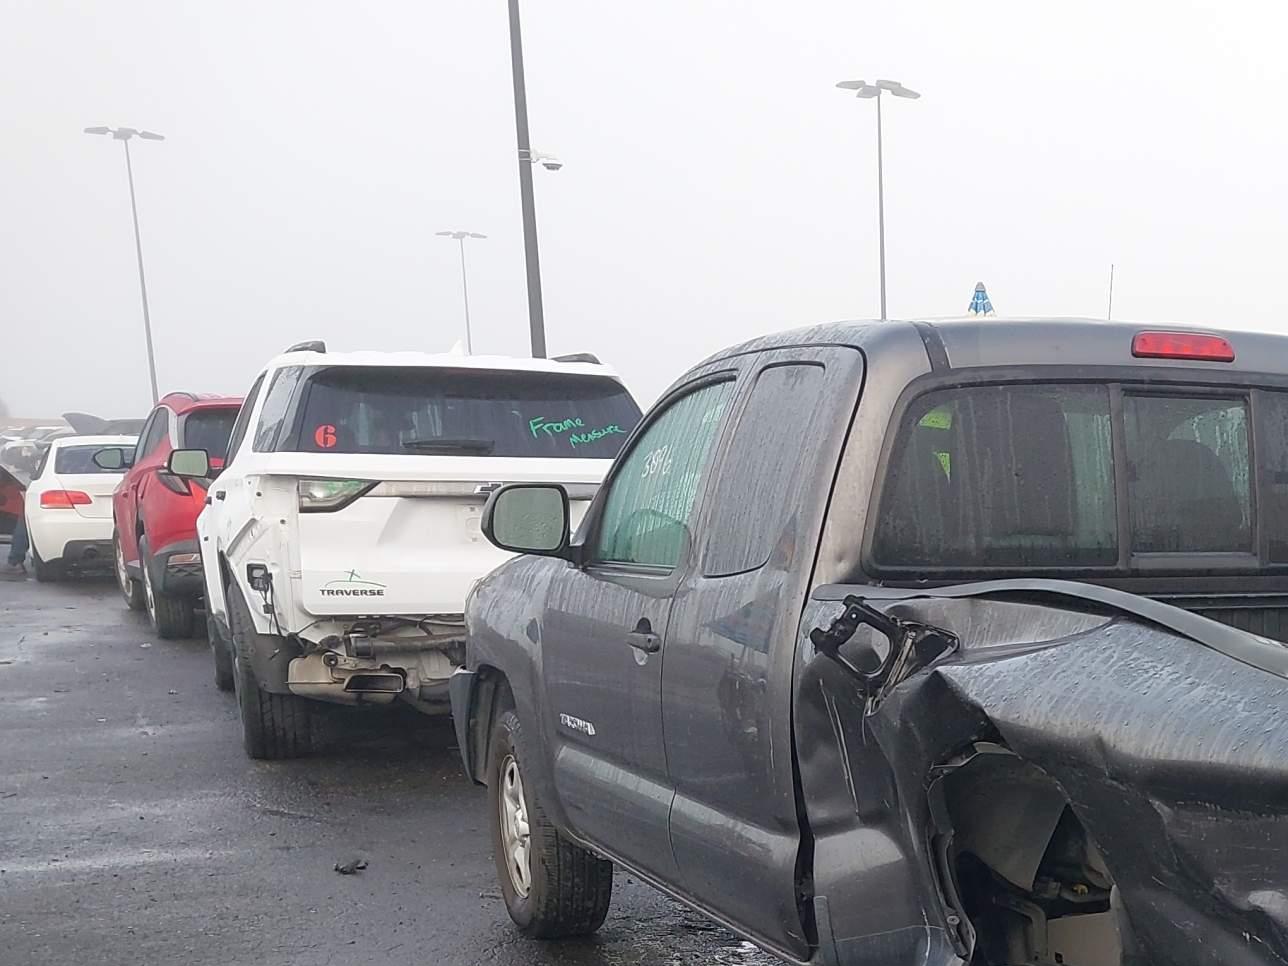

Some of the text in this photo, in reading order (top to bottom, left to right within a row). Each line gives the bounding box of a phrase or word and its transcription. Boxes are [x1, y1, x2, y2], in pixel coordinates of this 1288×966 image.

[315, 424, 337, 448] 6
[529, 416, 585, 439] Frame
[319, 588, 385, 597] TRAVERSE
